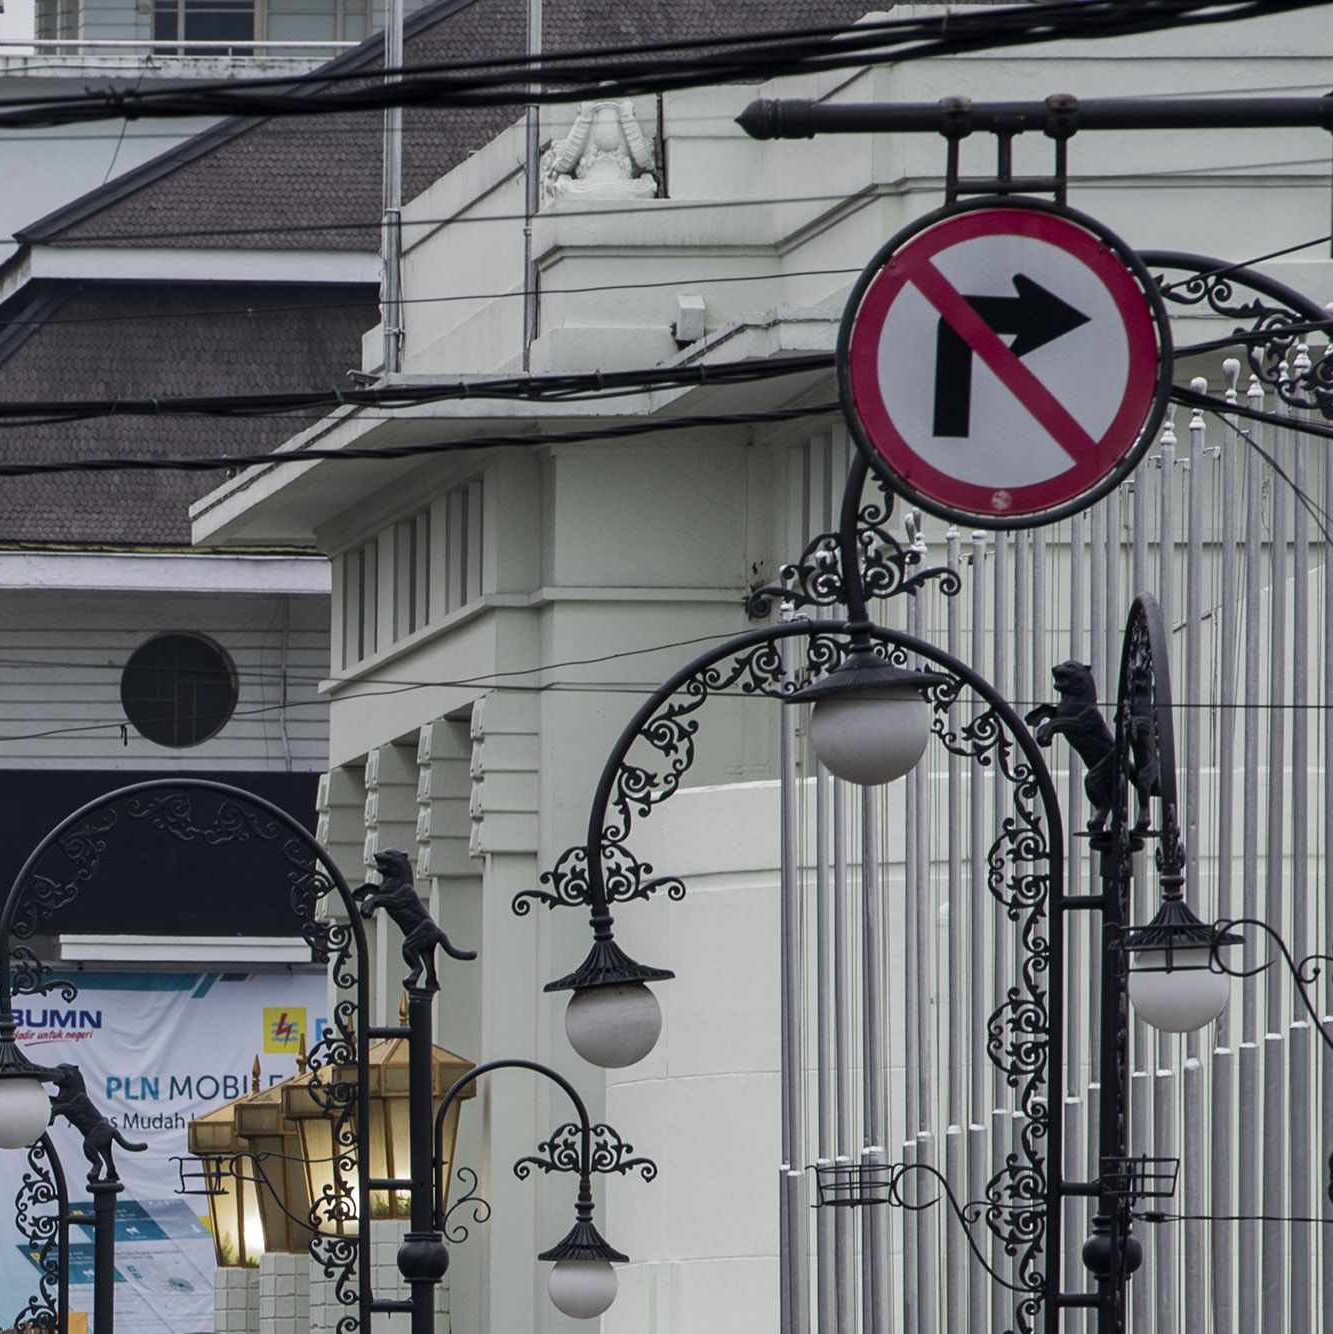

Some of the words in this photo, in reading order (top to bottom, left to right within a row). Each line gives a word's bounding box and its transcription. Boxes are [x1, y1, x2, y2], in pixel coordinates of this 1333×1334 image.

[10, 1008, 102, 1029] BUMN
[36, 1029, 63, 1040] untuk
[64, 1030, 94, 1043] negeri
[106, 1076, 160, 1101] PLN
[169, 1074, 284, 1101] MOBI
[123, 1112, 185, 1130] Mudah
